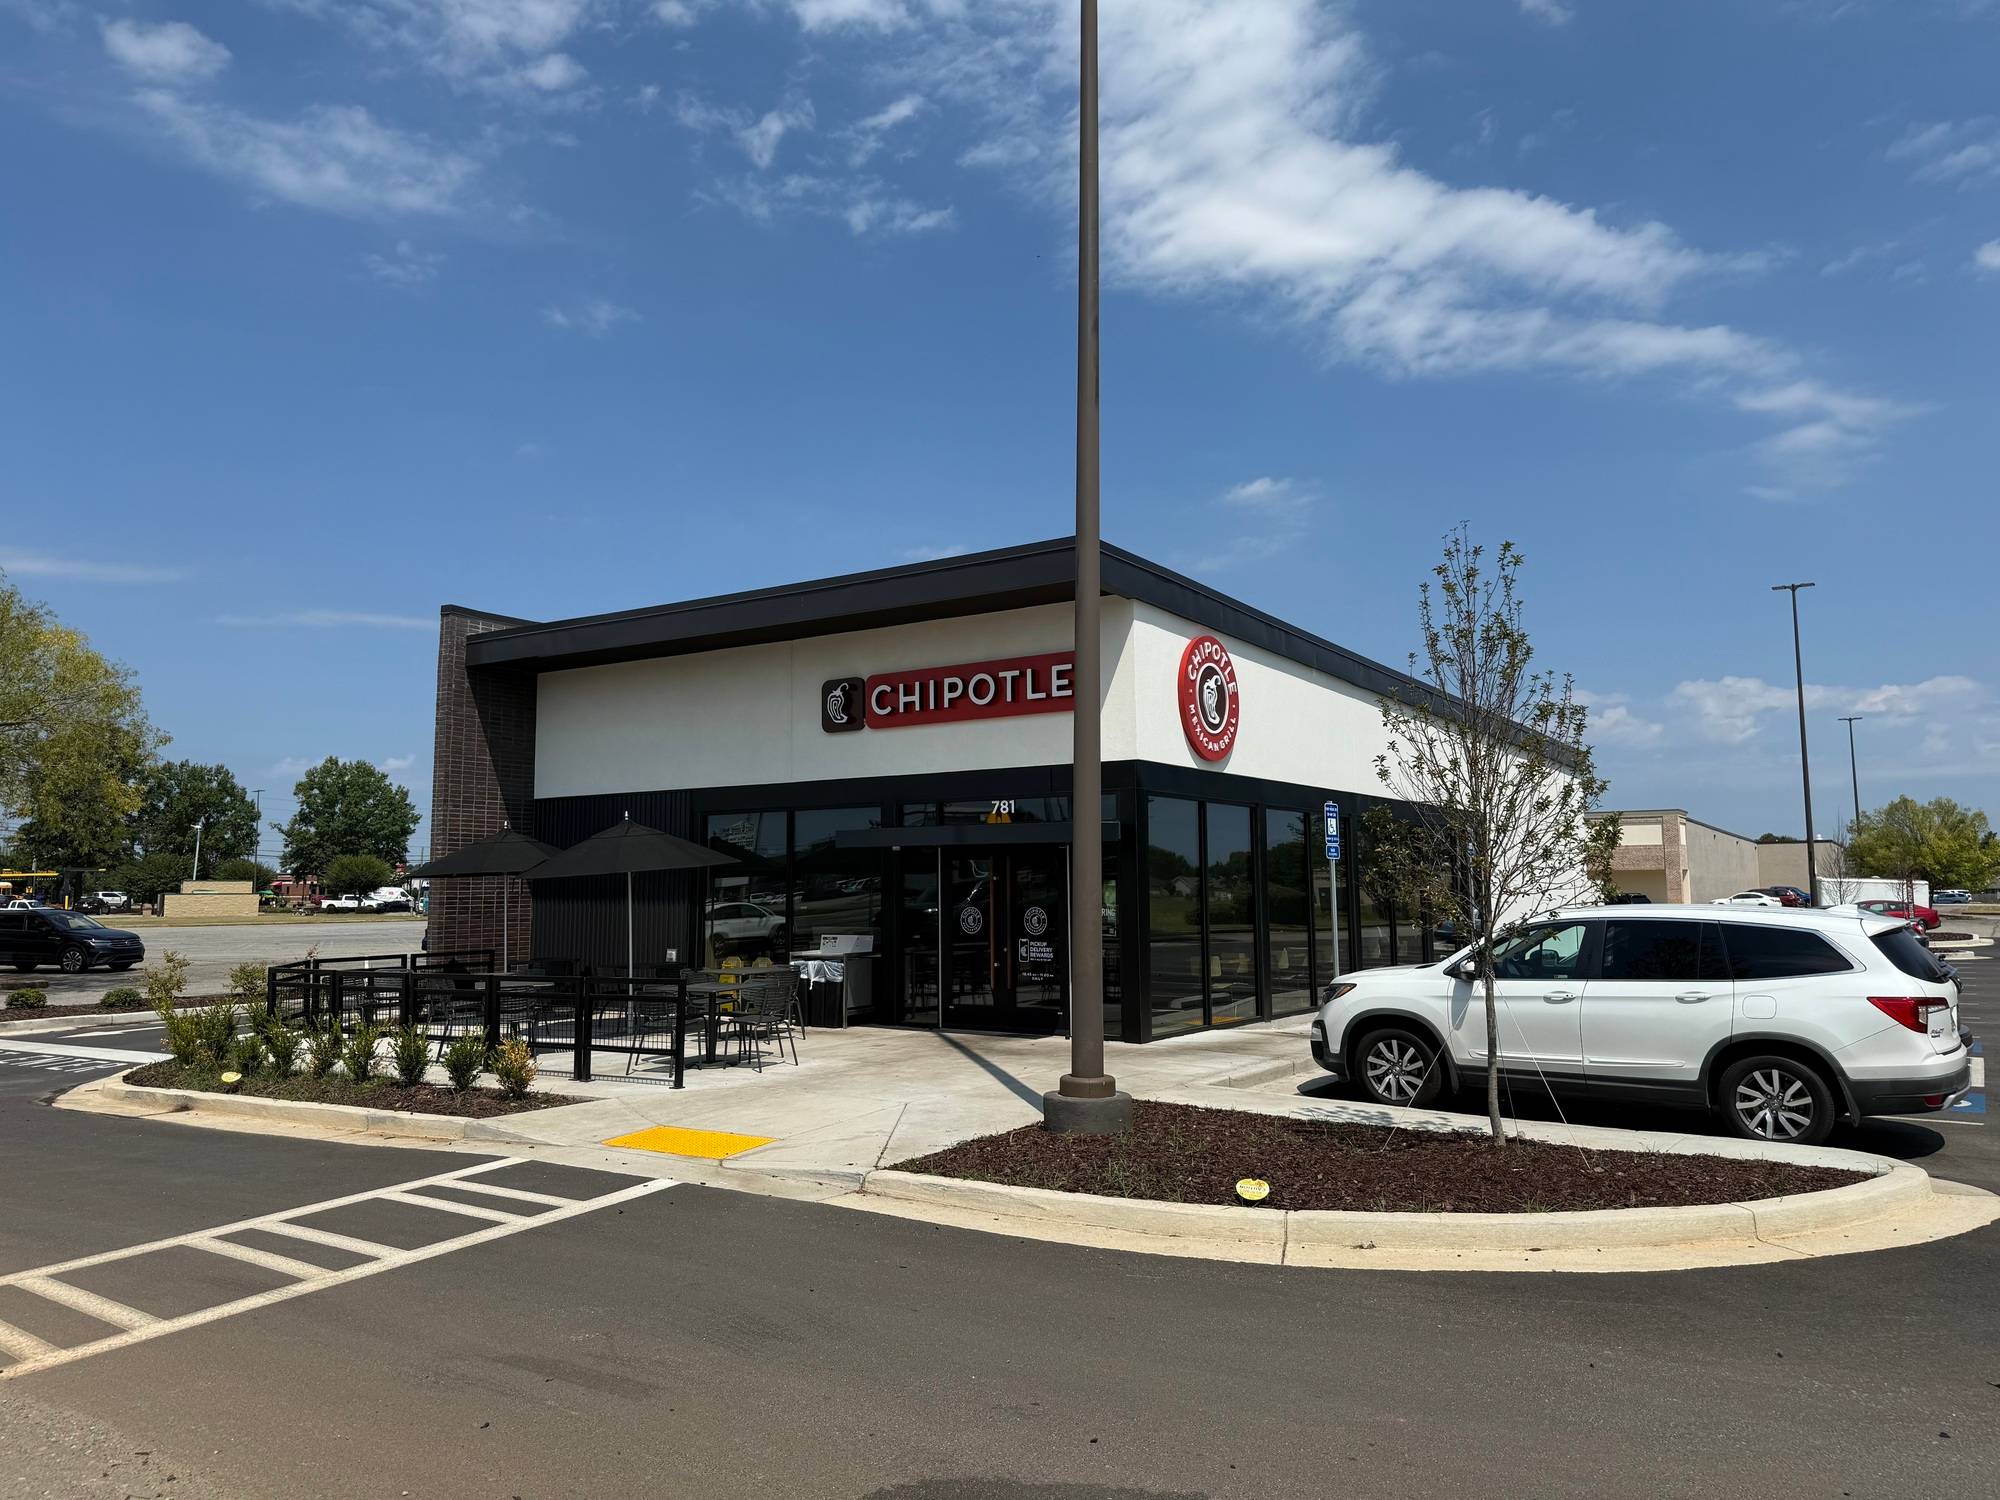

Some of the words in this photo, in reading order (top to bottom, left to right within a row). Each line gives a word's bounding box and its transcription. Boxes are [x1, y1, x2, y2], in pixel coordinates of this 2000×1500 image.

[871, 663, 1073, 716] CHIPOTLE
[1188, 641, 1237, 695] CHIPOTLE
[1188, 704, 1219, 752] MEXICAN
[1219, 717, 1236, 750] GRILL
[991, 799, 1015, 814] 781
[0, 1054, 129, 1073] ENTER
